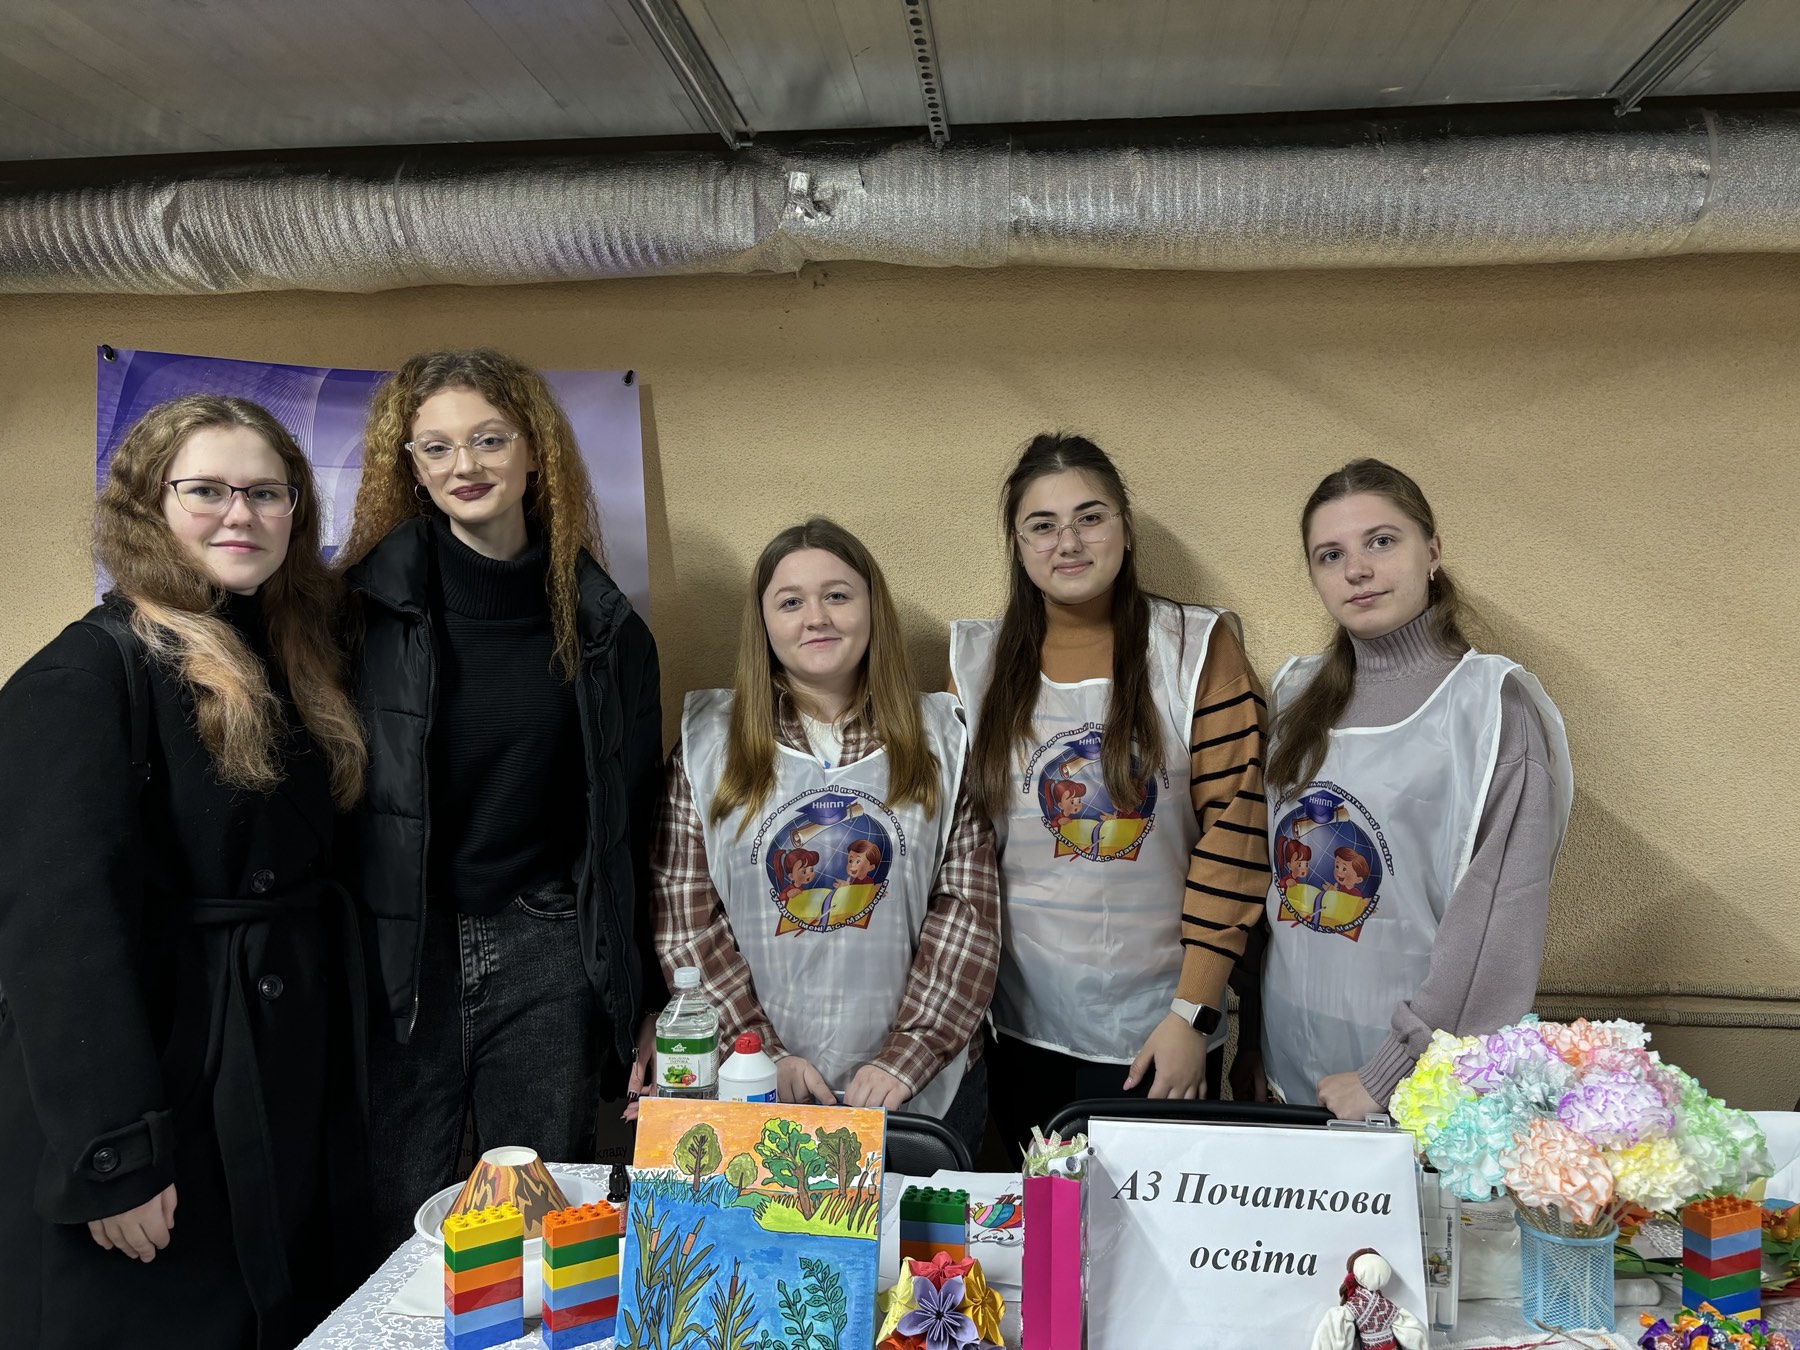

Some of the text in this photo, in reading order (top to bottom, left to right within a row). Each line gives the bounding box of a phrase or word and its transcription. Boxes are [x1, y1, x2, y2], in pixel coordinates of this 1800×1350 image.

[1079, 736, 1101, 746] ННІП
[812, 801, 844, 809] ННІПП
[846, 879, 889, 925] Макаренка
[1172, 1171, 1393, 1216] Початкова
[1189, 1239, 1319, 1277] освіта
